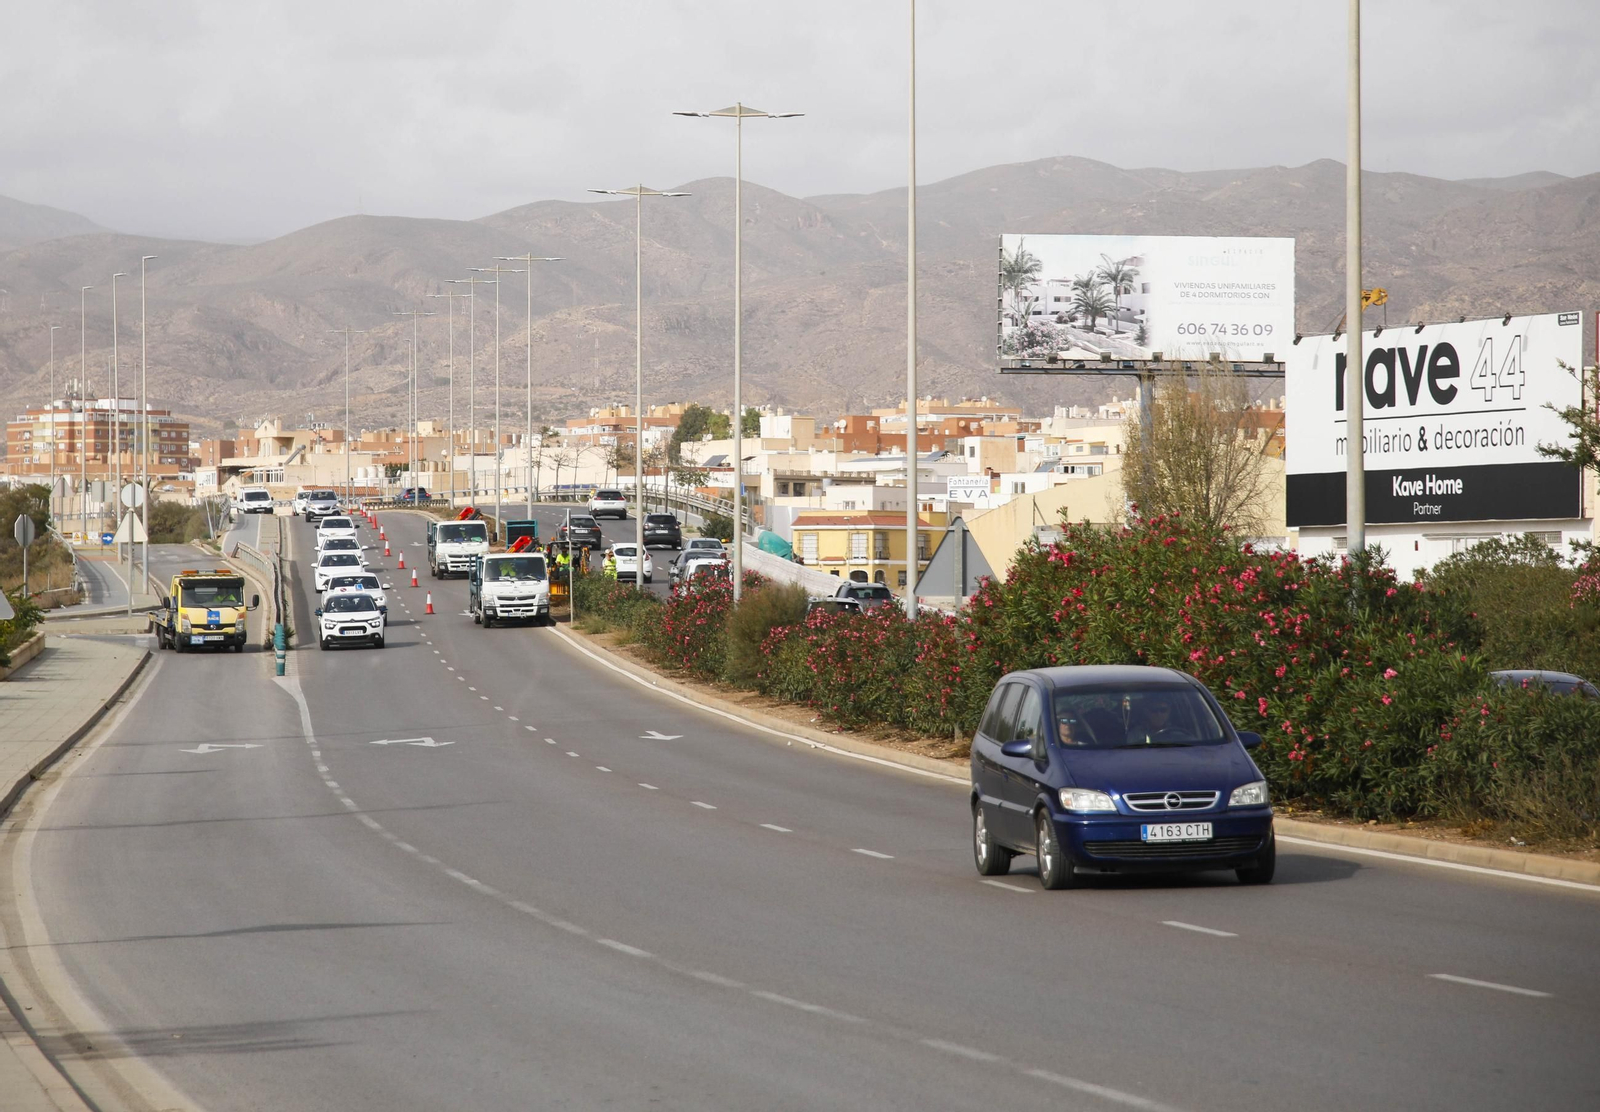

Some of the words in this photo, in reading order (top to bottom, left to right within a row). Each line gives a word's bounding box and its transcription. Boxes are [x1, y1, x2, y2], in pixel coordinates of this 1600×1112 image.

[1174, 281, 1216, 290] VIVIENDAS
[1217, 282, 1276, 291] UNIFAMILIARES
[1180, 290, 1190, 298] DE
[1198, 291, 1251, 299] DORMITORIOS
[1176, 322, 1207, 336] 606
[1210, 323, 1228, 336] 74
[1230, 323, 1249, 336] 36
[1252, 324, 1274, 337] 09
[1470, 334, 1526, 403] 44
[1336, 427, 1412, 456] miliario
[1417, 426, 1428, 452] &
[1434, 419, 1525, 450] decoración
[1392, 475, 1423, 497] Kave
[1426, 474, 1463, 495] Home
[949, 489, 988, 499] EVA
[1413, 502, 1442, 515] Partner
[1150, 825, 1182, 838] 4163
[1186, 824, 1210, 836] CTH
